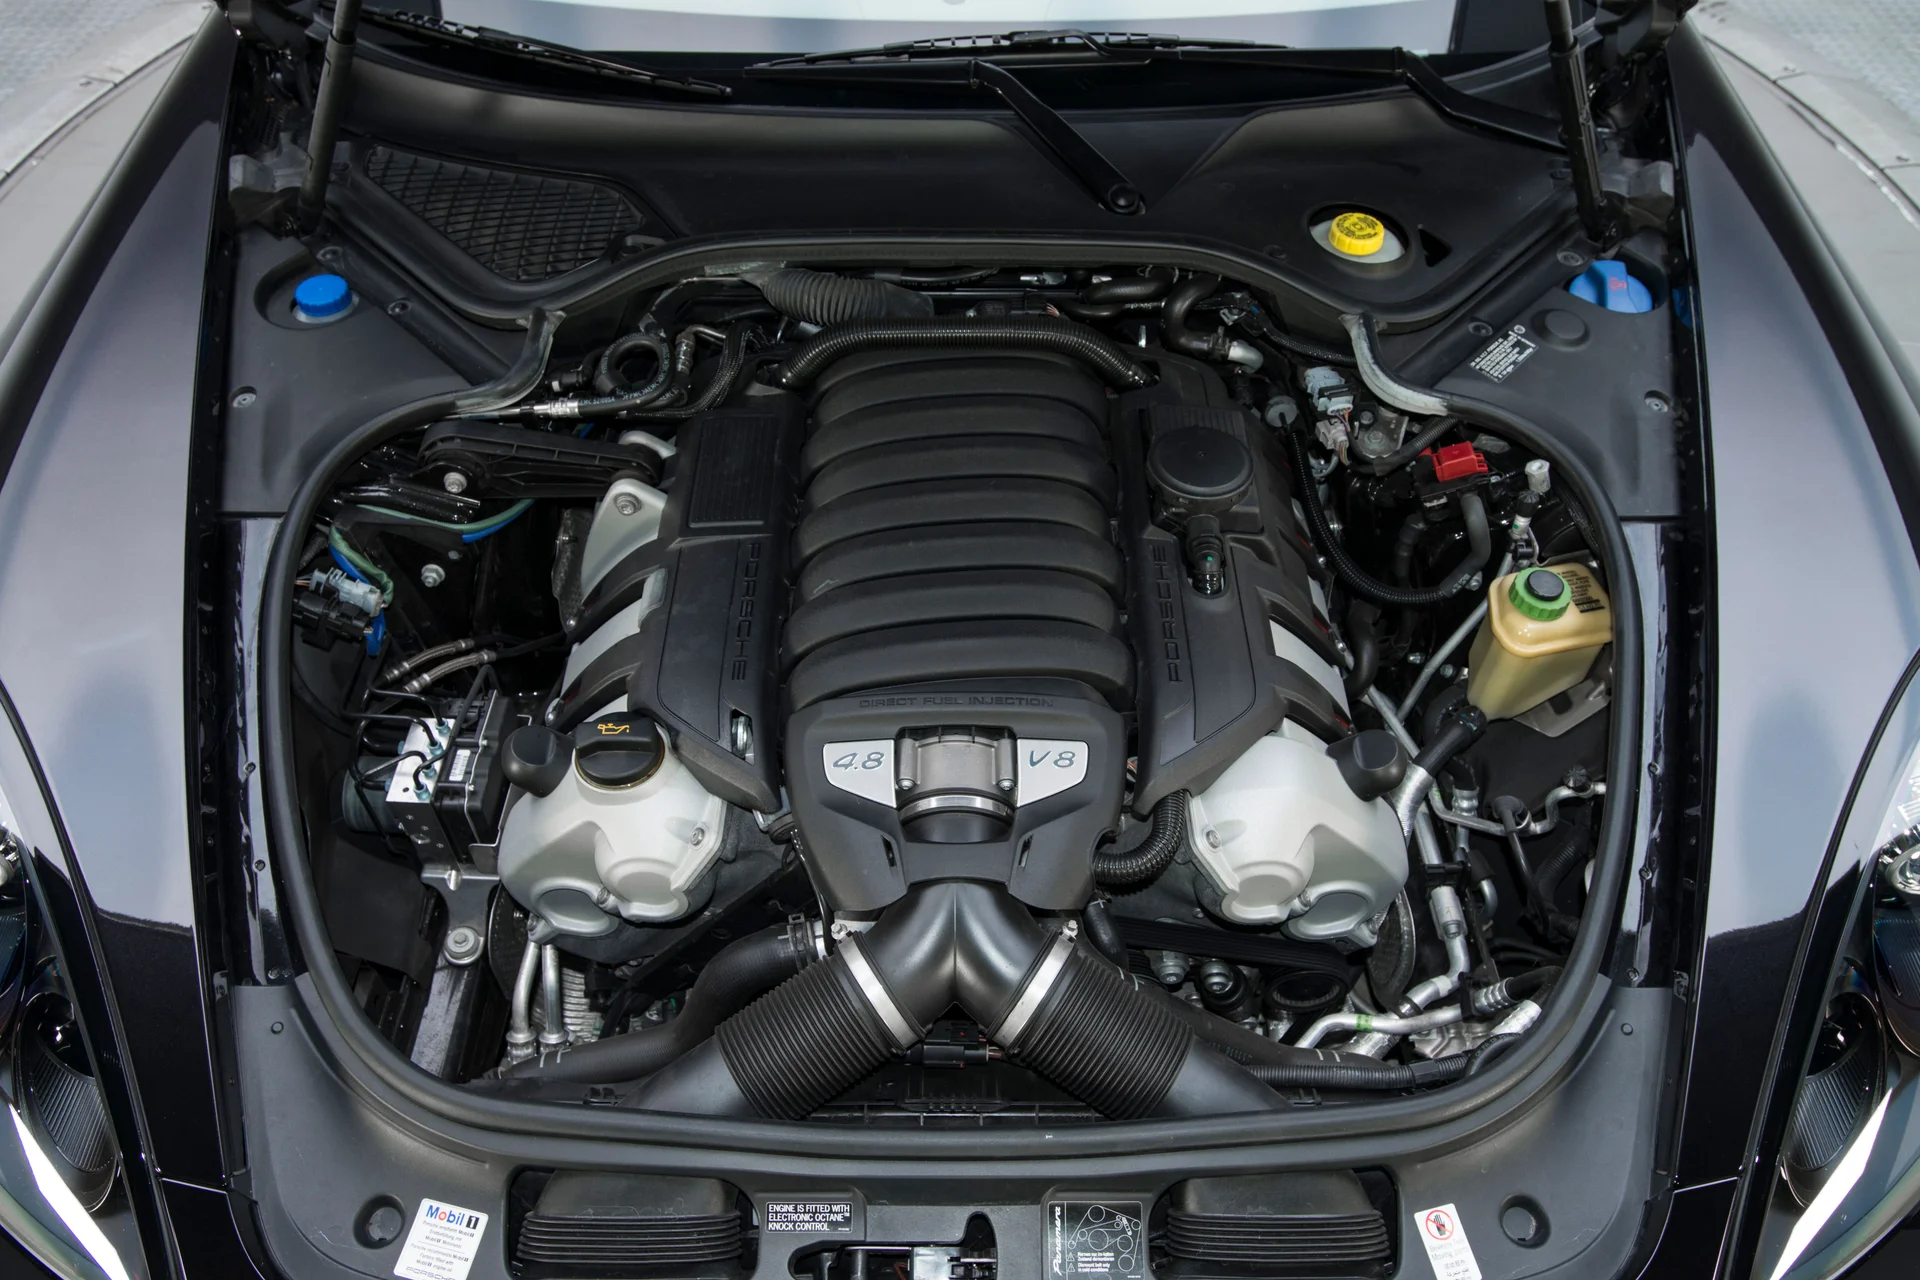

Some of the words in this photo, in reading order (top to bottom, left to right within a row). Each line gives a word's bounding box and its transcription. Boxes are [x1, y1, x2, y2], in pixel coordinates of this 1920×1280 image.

[731, 541, 761, 682] PORSCHE
[1150, 543, 1184, 683] PORSCHE
[859, 697, 918, 708] DIRECT
[923, 696, 962, 706] FUEL
[968, 696, 1055, 708] INJECTION
[832, 750, 885, 771] 4.8
[425, 1204, 466, 1226] Mobil
[768, 1204, 796, 1213] ENGINE
[797, 1204, 805, 1213] IS
[805, 1204, 830, 1213] FITTED
[831, 1204, 850, 1213] WITH
[768, 1213, 814, 1222] ELECTRONIC
[768, 1222, 794, 1231] KNOCK
[795, 1222, 830, 1231] CONTROL
[1053, 1206, 1063, 1277] Panamera
[1431, 1252, 1454, 1261] Moving
